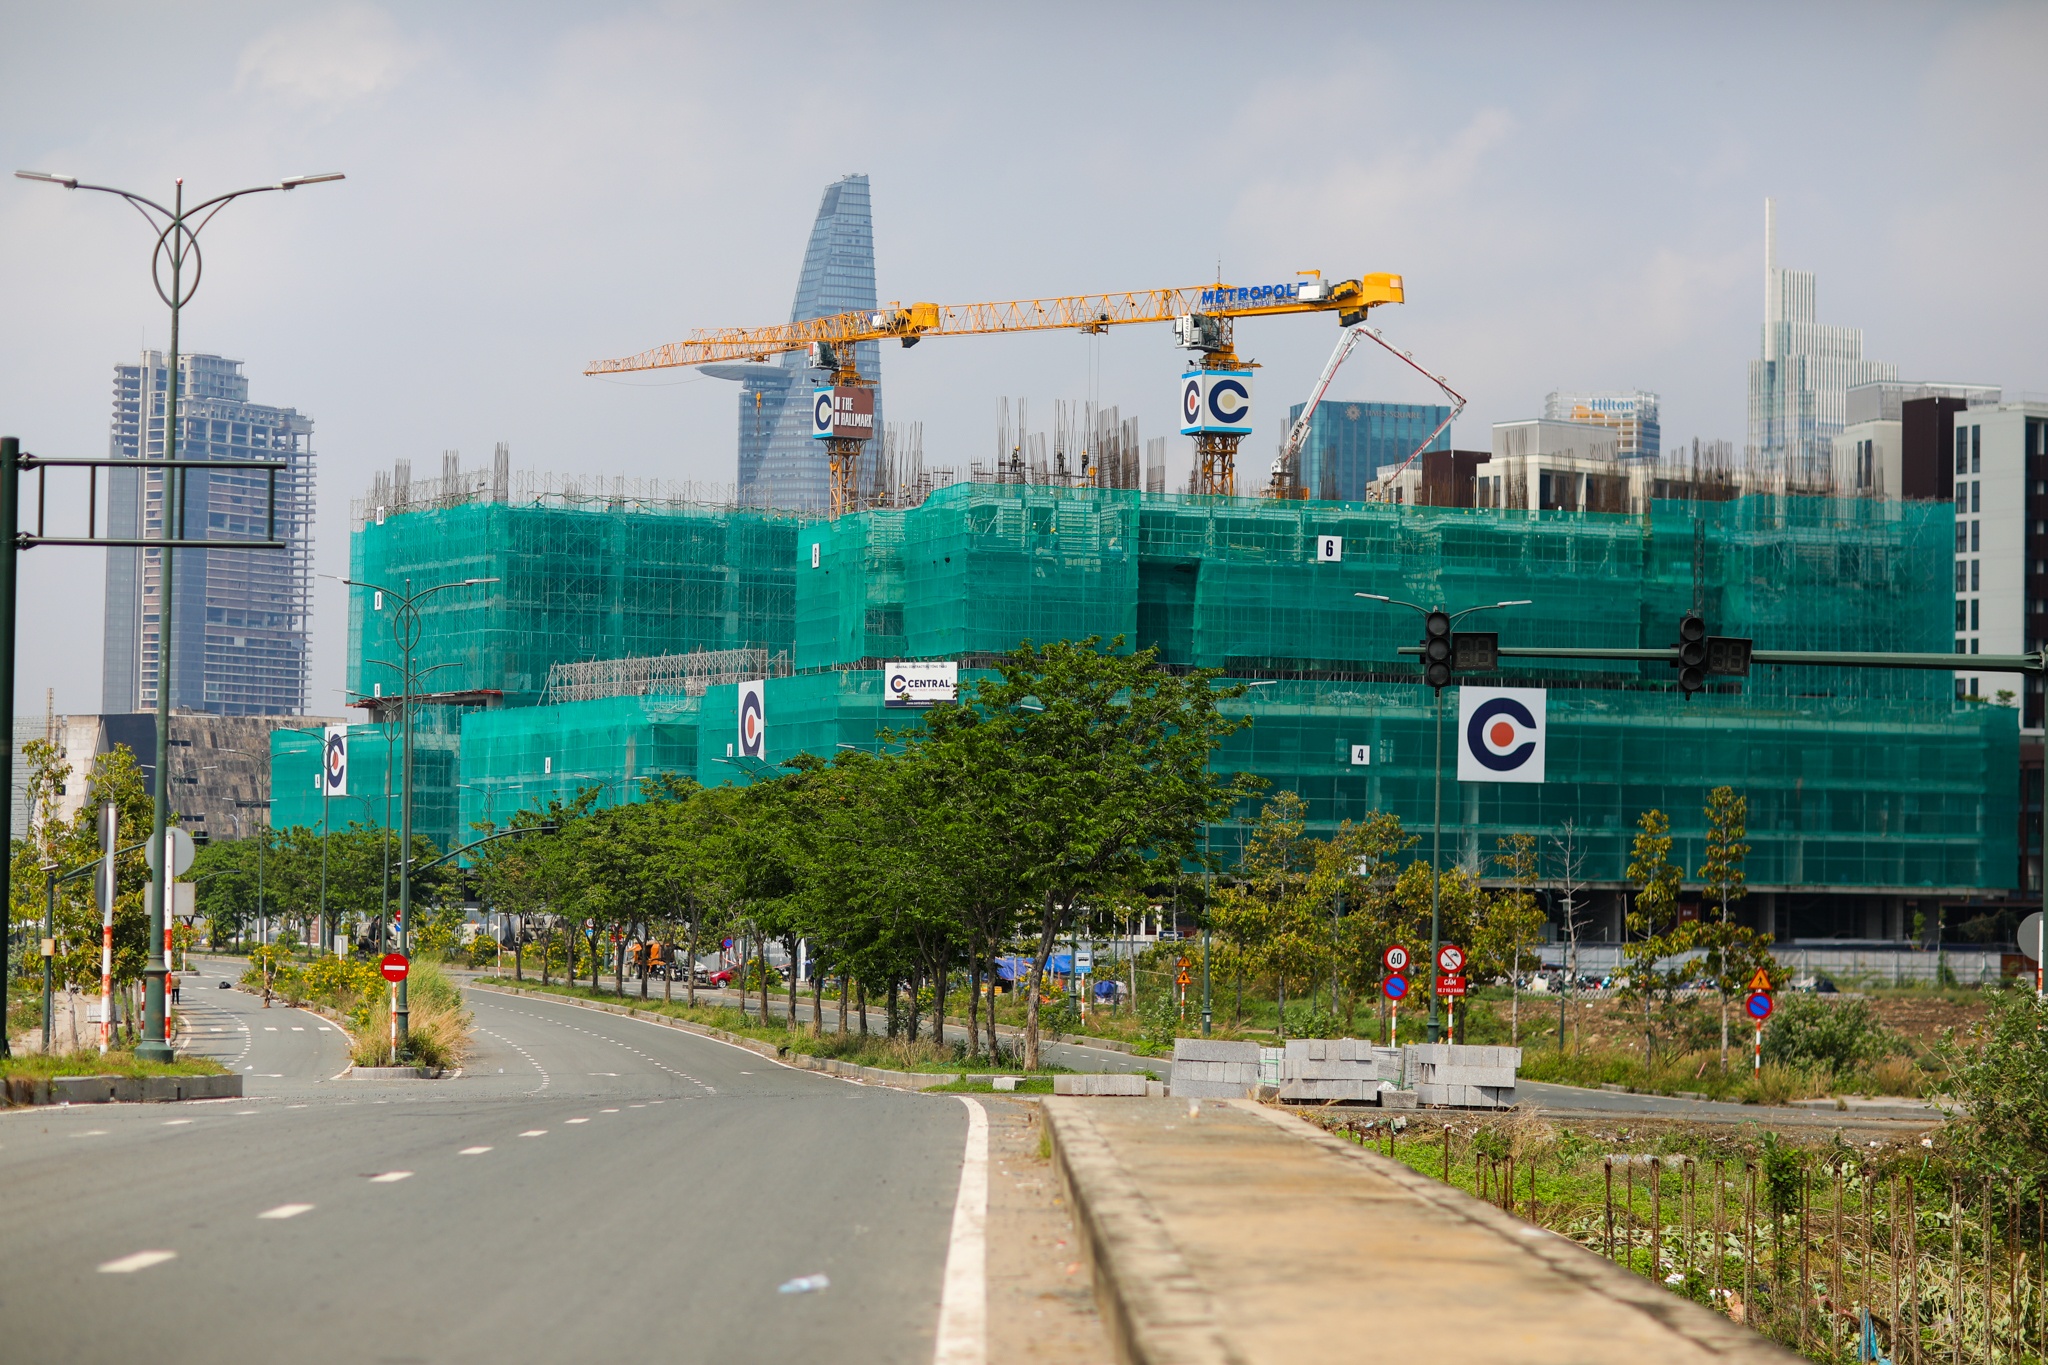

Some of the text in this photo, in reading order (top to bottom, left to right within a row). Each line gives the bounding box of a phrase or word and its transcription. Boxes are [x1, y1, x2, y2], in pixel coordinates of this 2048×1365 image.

[842, 397, 853, 411] THE
[1591, 398, 1634, 411] Hilton
[841, 412, 873, 428] HALLMARK
[1389, 411, 1421, 419] SQUARE
[1325, 539, 1334, 558] 6
[908, 679, 950, 688] CENTRAL
[1357, 748, 1364, 762] 4
[1391, 952, 1403, 965] 60
